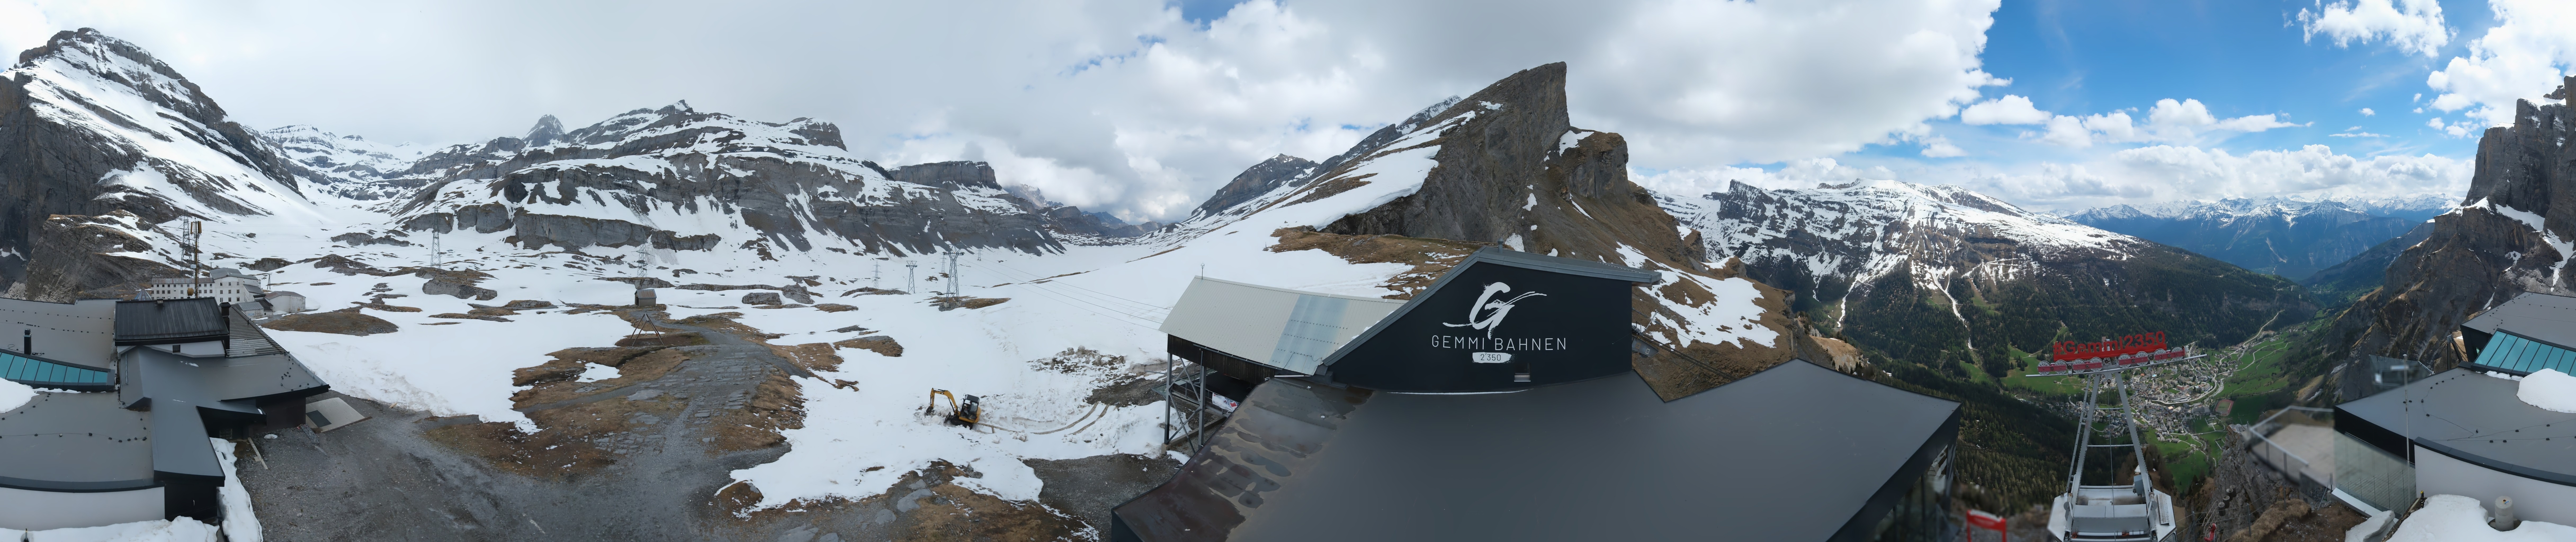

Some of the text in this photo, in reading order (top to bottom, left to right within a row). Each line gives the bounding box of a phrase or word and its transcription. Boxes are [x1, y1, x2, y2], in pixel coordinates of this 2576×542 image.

[1432, 335, 1566, 350] GEMMI BAHNEN
[2053, 331, 2165, 355] #Gemmi2350
